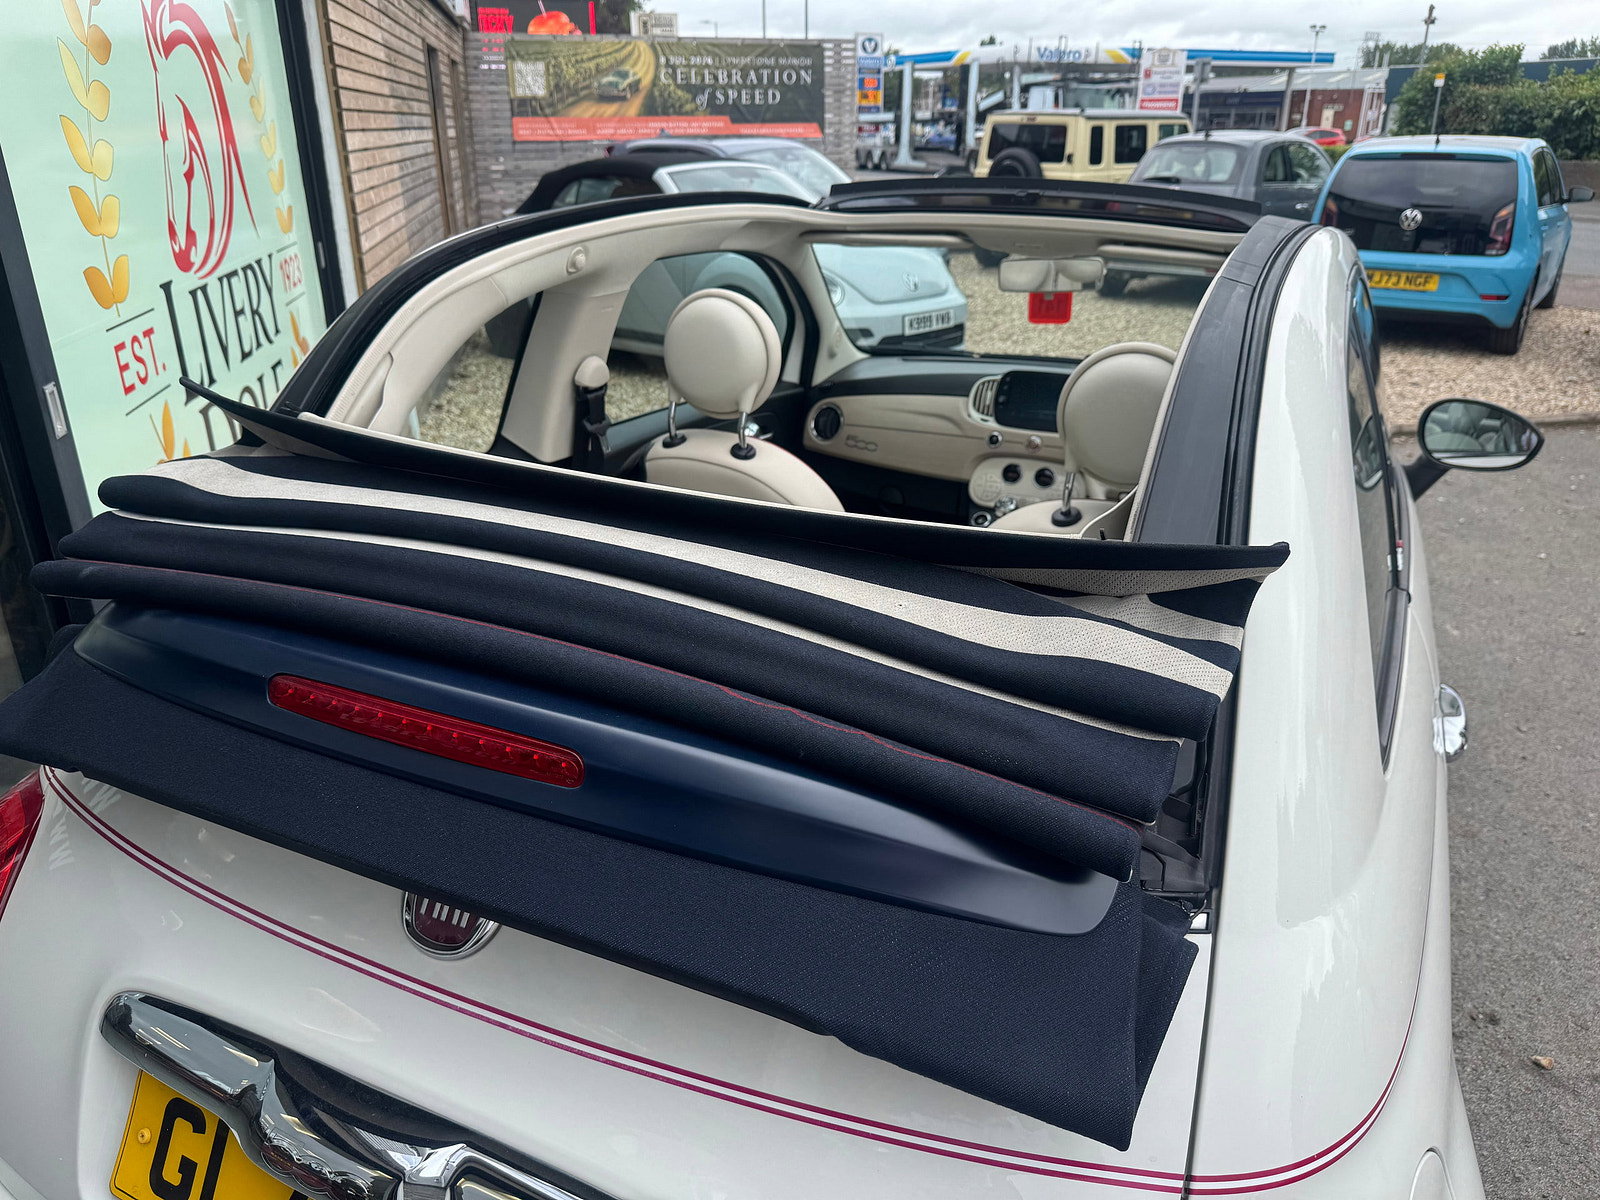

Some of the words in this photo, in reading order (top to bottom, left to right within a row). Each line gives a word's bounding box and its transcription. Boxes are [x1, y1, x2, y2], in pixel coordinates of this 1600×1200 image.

[660, 68, 813, 85] CELEBRATION
[696, 88, 712, 110] of
[715, 88, 781, 105] SPEED
[113, 326, 167, 396] EST.
[159, 252, 282, 407] LIVERY
